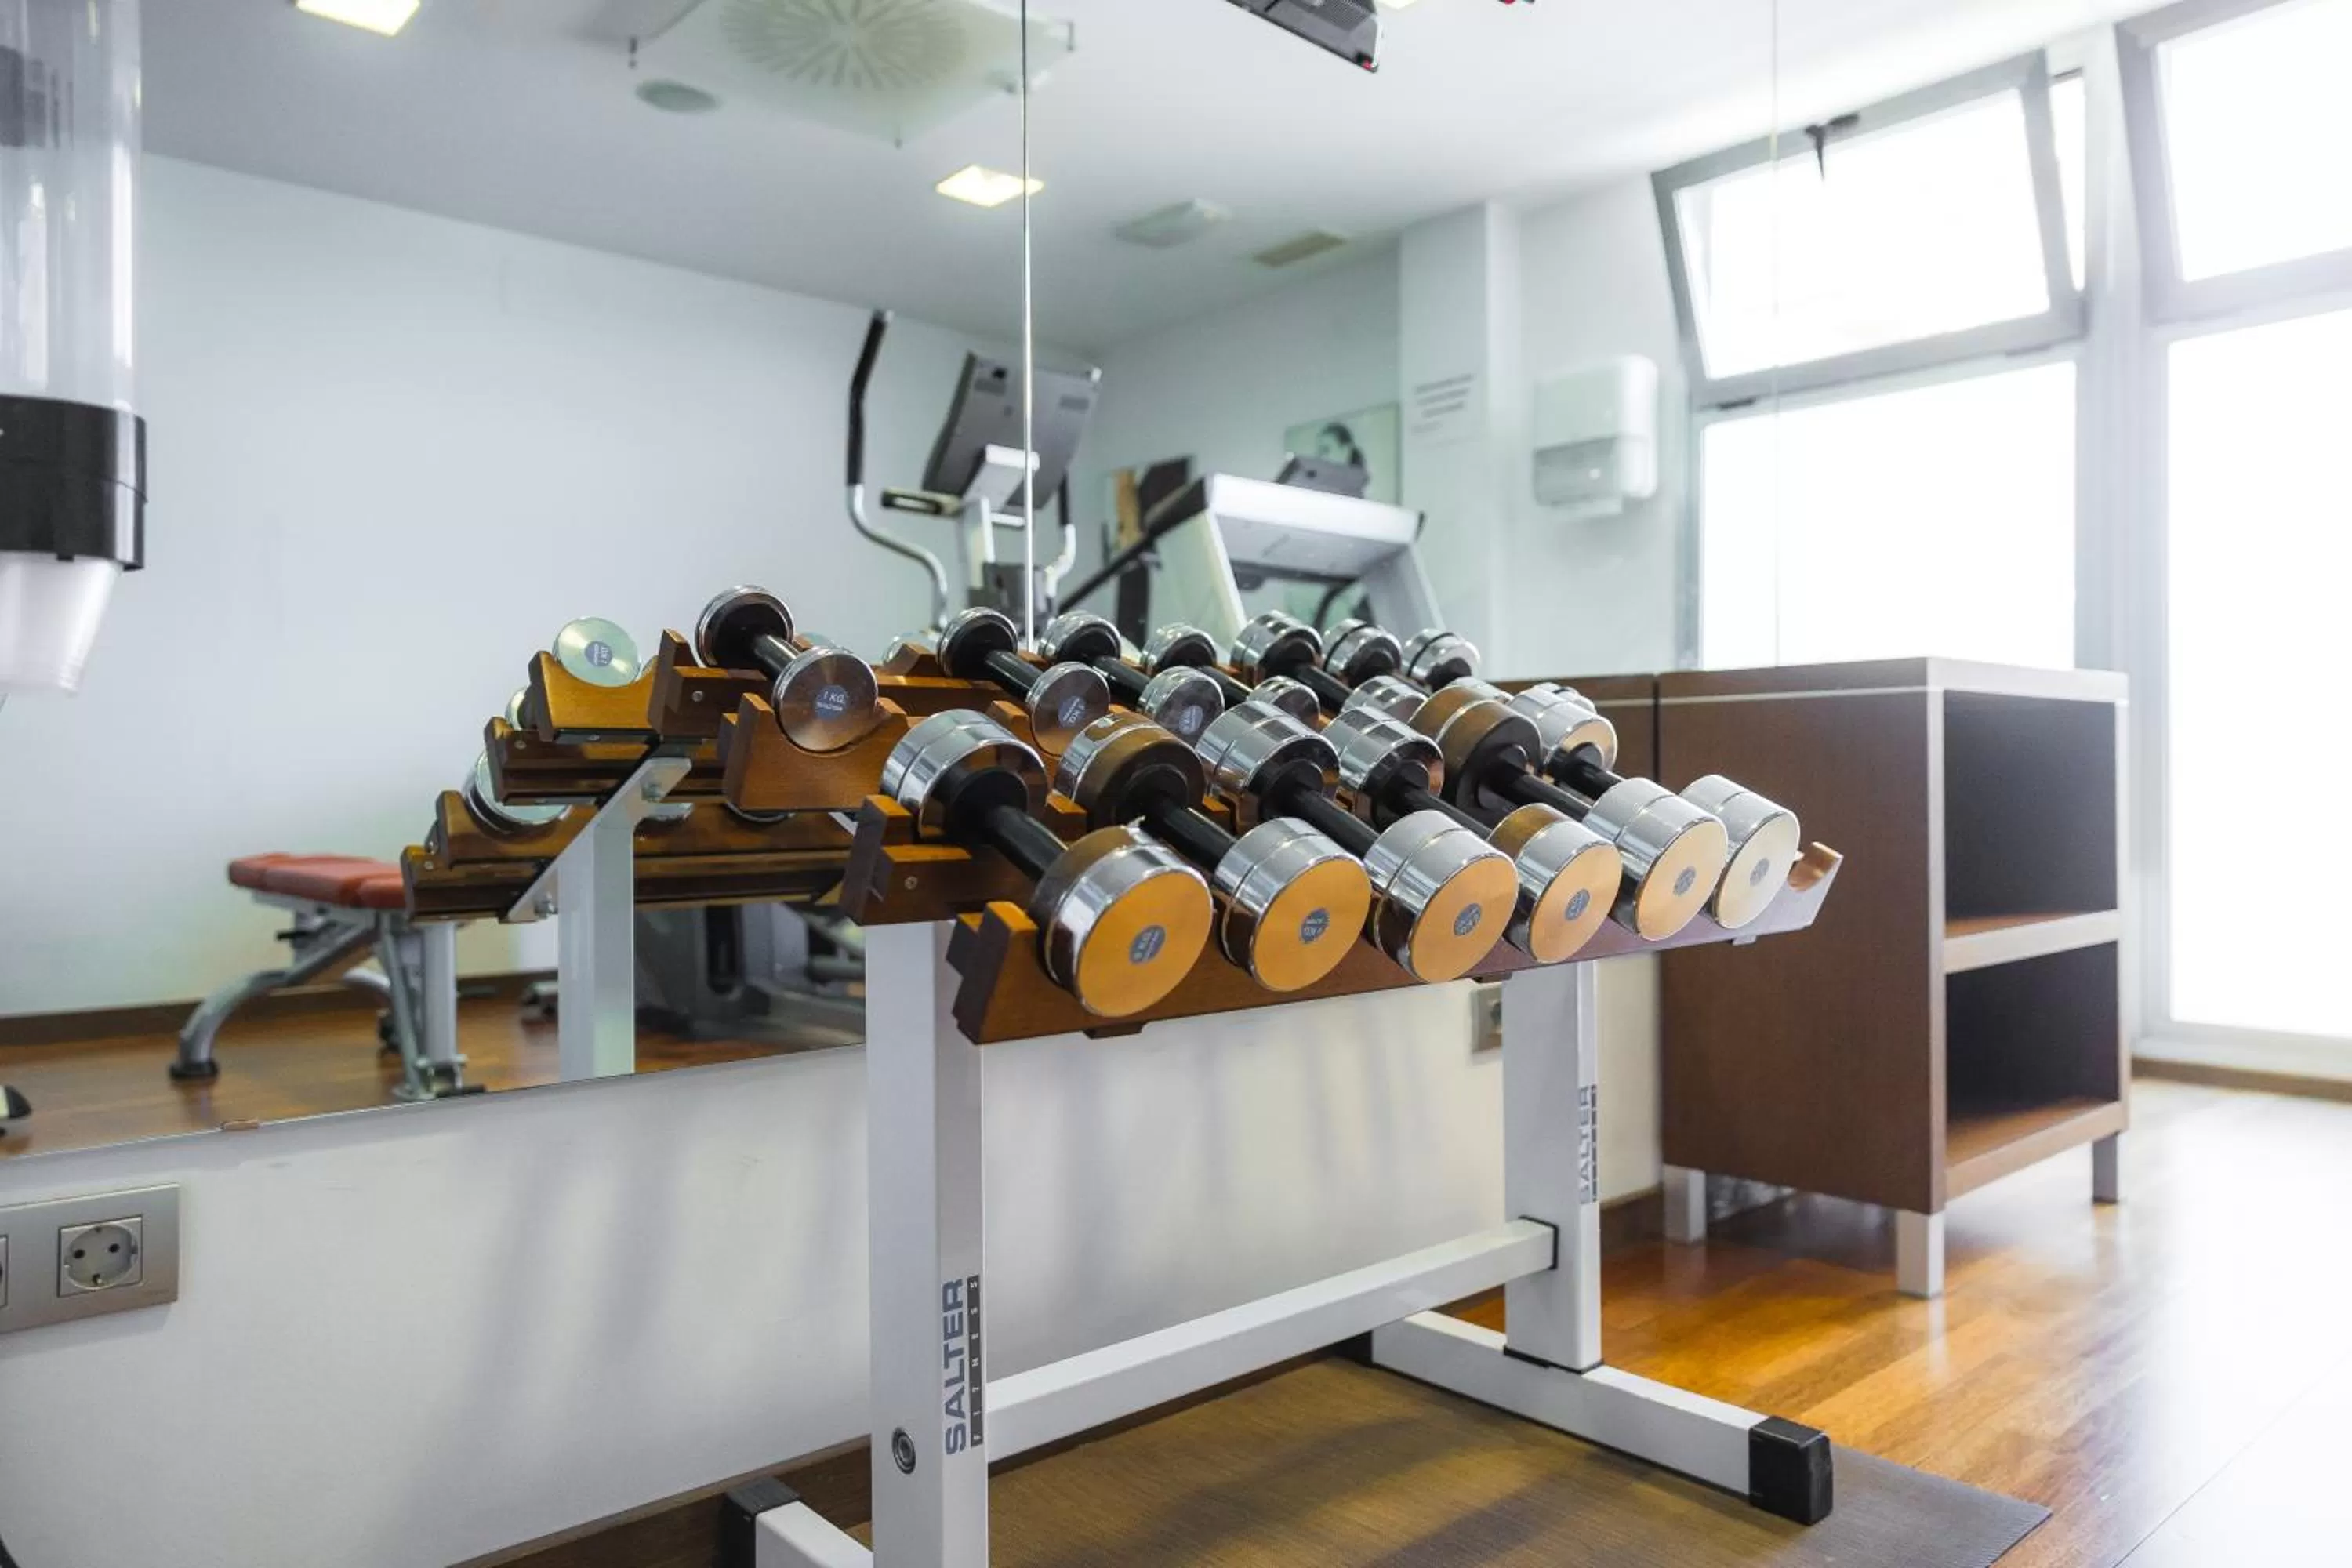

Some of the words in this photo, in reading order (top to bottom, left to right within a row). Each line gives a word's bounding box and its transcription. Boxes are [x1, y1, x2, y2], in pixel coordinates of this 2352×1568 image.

[829, 692, 845, 703] KG
[942, 1279, 966, 1455] SALTER
[970, 1280, 982, 1443] FITNESS
